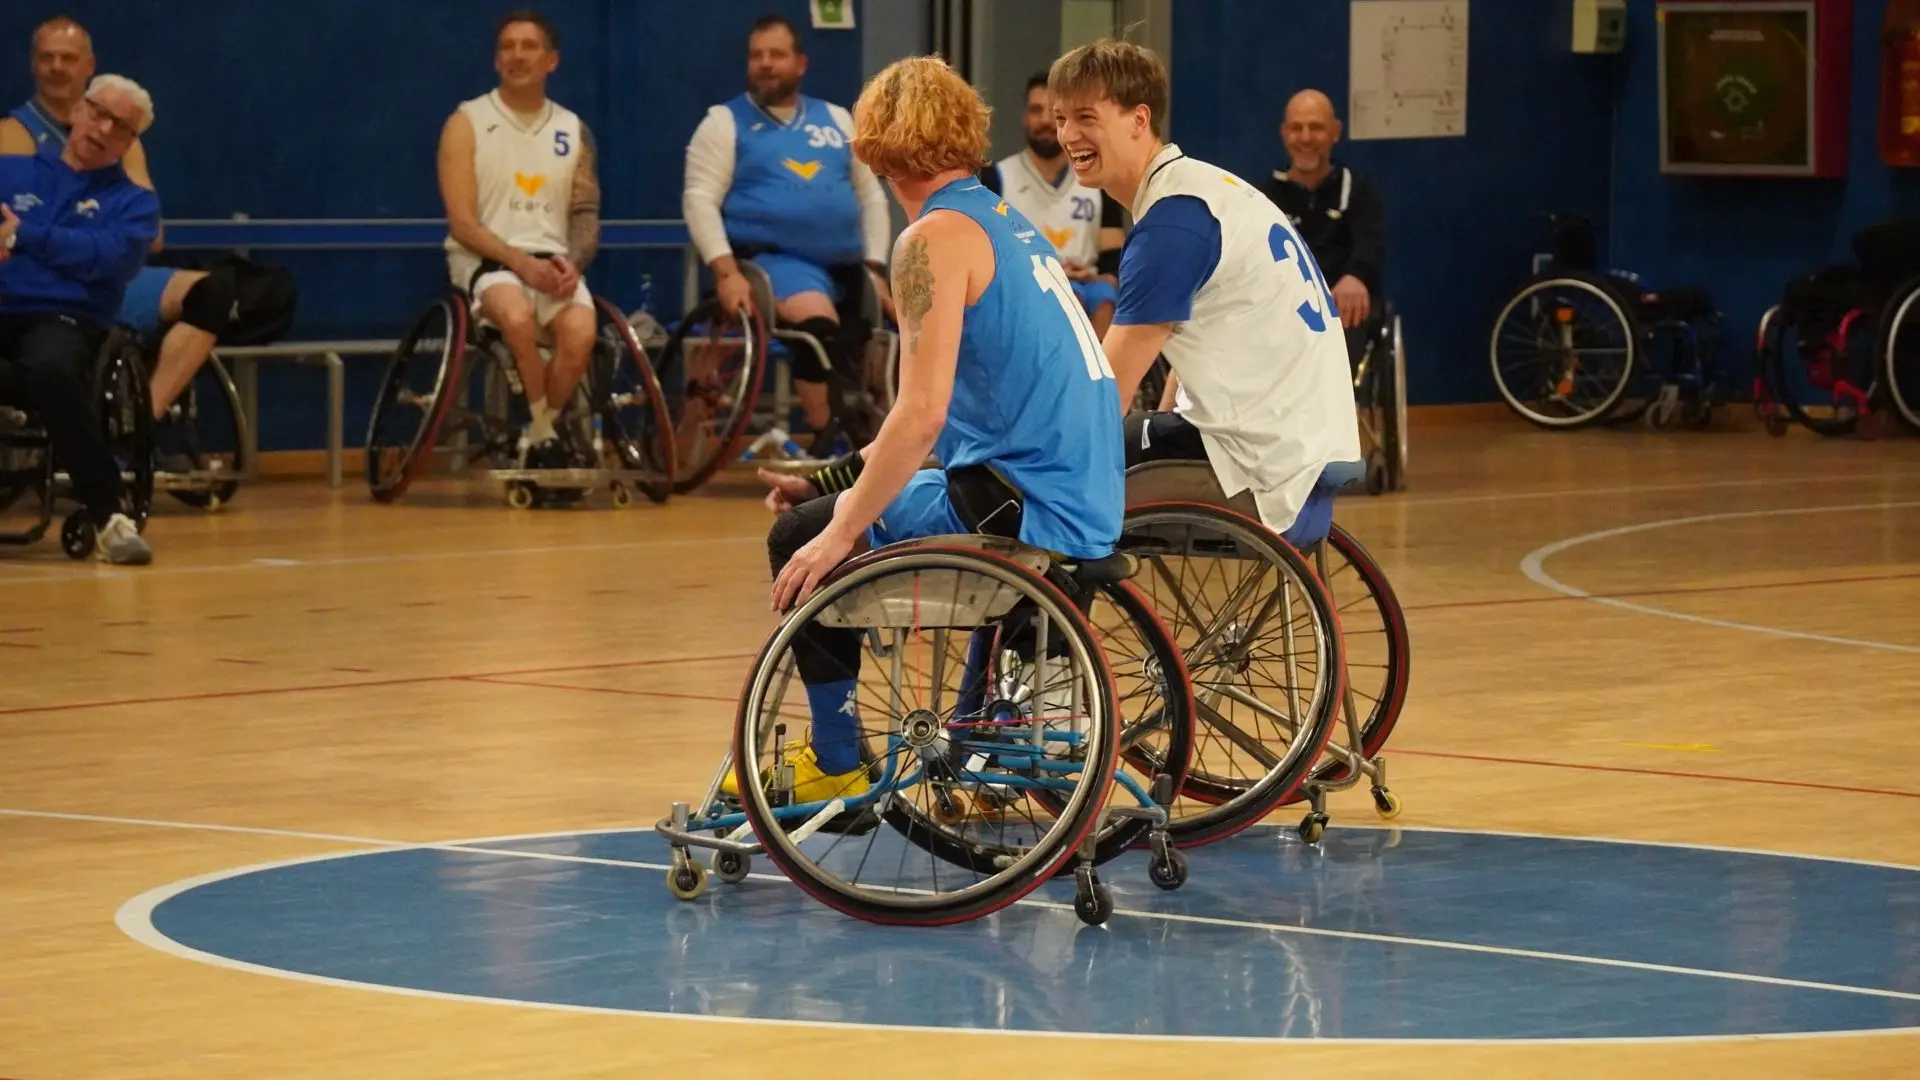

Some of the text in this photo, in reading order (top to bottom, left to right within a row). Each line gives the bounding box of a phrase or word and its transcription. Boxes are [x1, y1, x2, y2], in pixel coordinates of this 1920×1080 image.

[554, 131, 570, 157] 5
[803, 124, 843, 148] 30
[1070, 195, 1095, 222] 20
